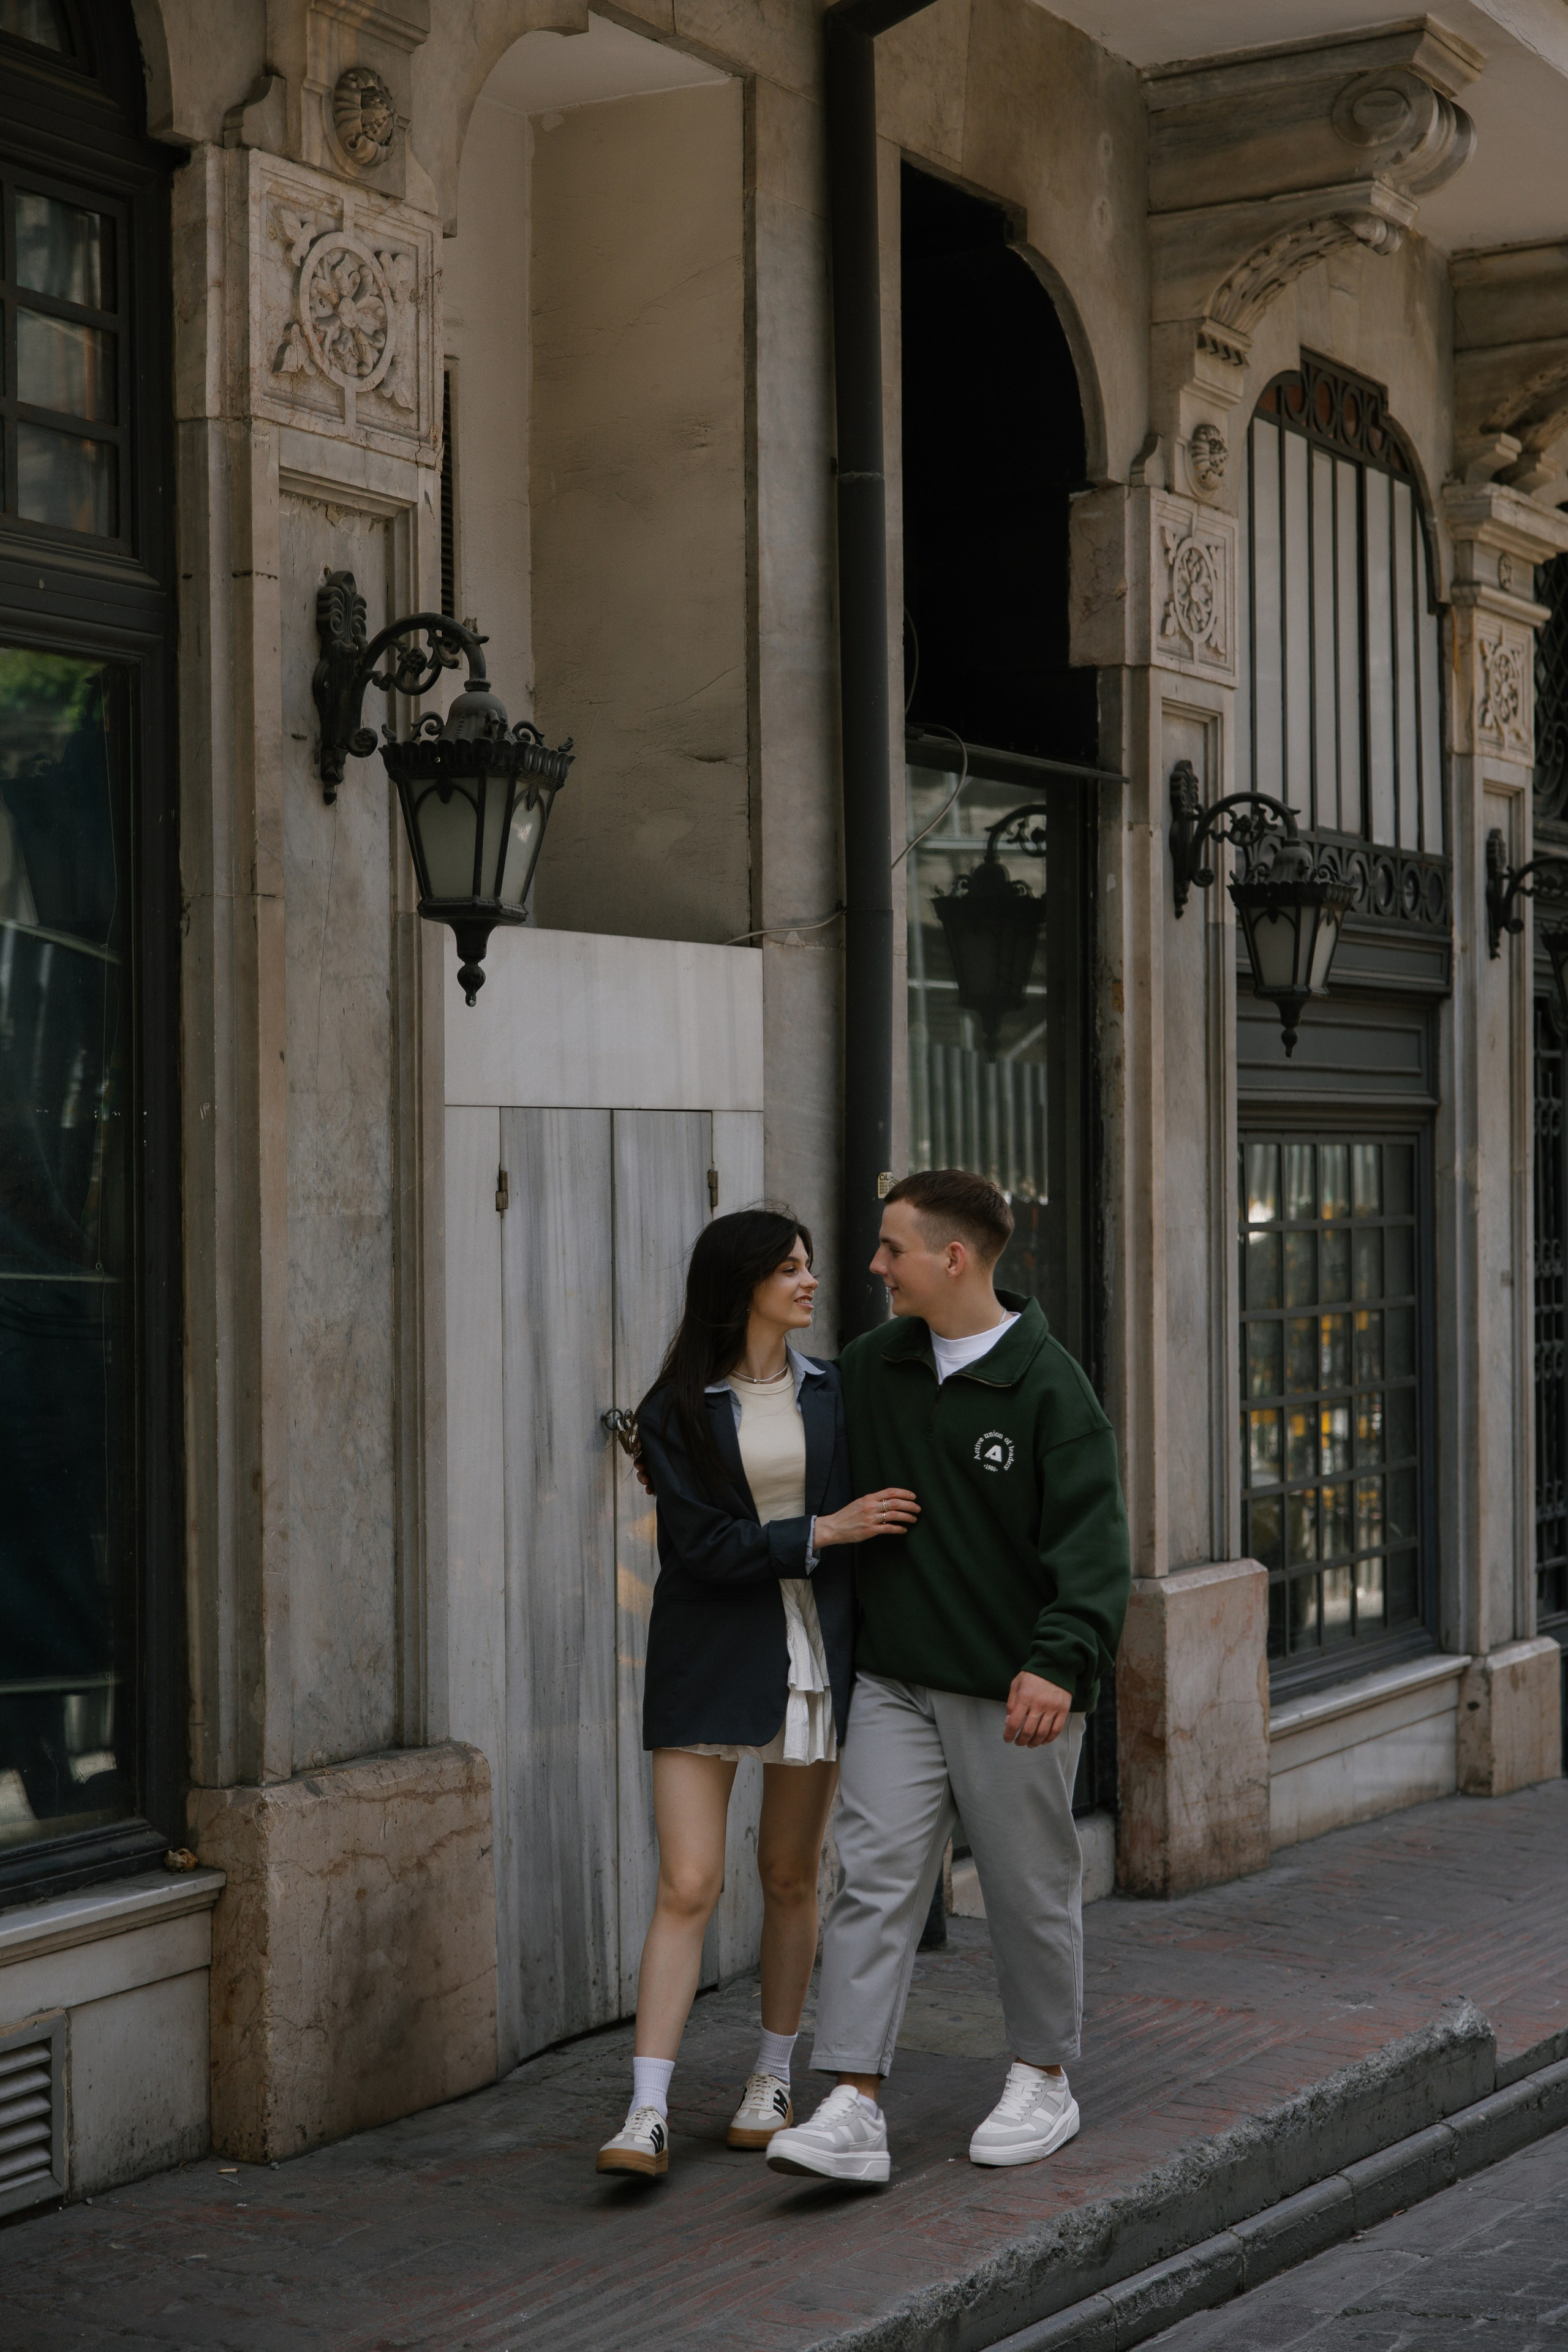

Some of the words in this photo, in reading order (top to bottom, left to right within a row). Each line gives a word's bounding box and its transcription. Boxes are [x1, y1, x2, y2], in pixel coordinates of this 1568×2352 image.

[973, 1437, 984, 1460] Active
[983, 1430, 1003, 1439] union
[1003, 1446, 1015, 1471] leaders
